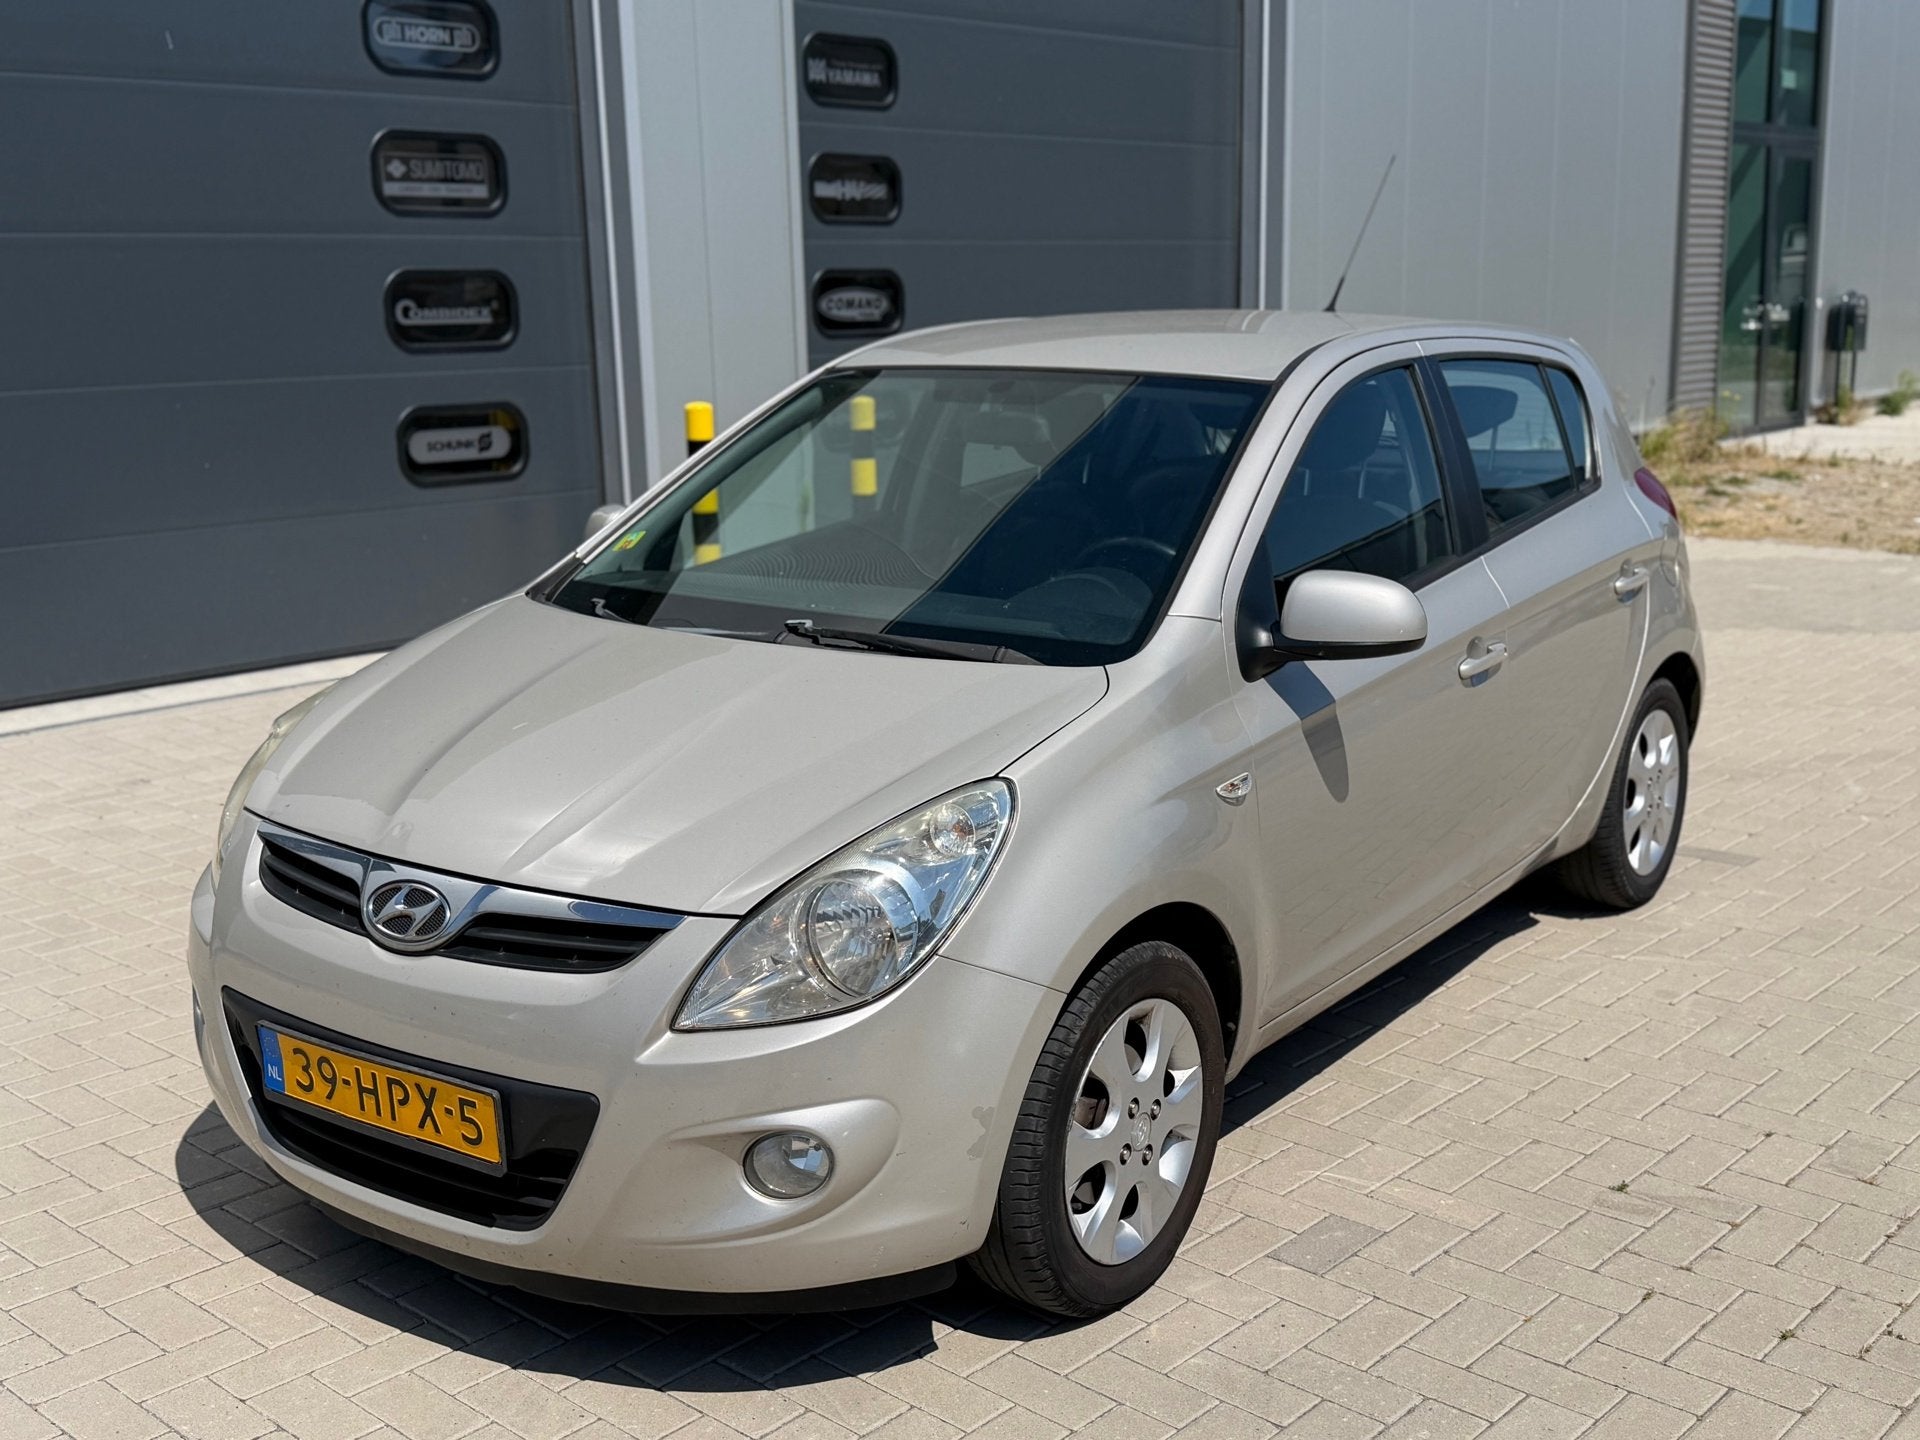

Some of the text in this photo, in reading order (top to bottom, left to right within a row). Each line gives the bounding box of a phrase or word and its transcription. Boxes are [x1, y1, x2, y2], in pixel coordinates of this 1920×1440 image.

[403, 24, 452, 45] HORN
[409, 159, 485, 181] SUMITOMO
[426, 439, 476, 453] SCHUNK
[267, 1047, 483, 1146] NL 39-HPX-5
